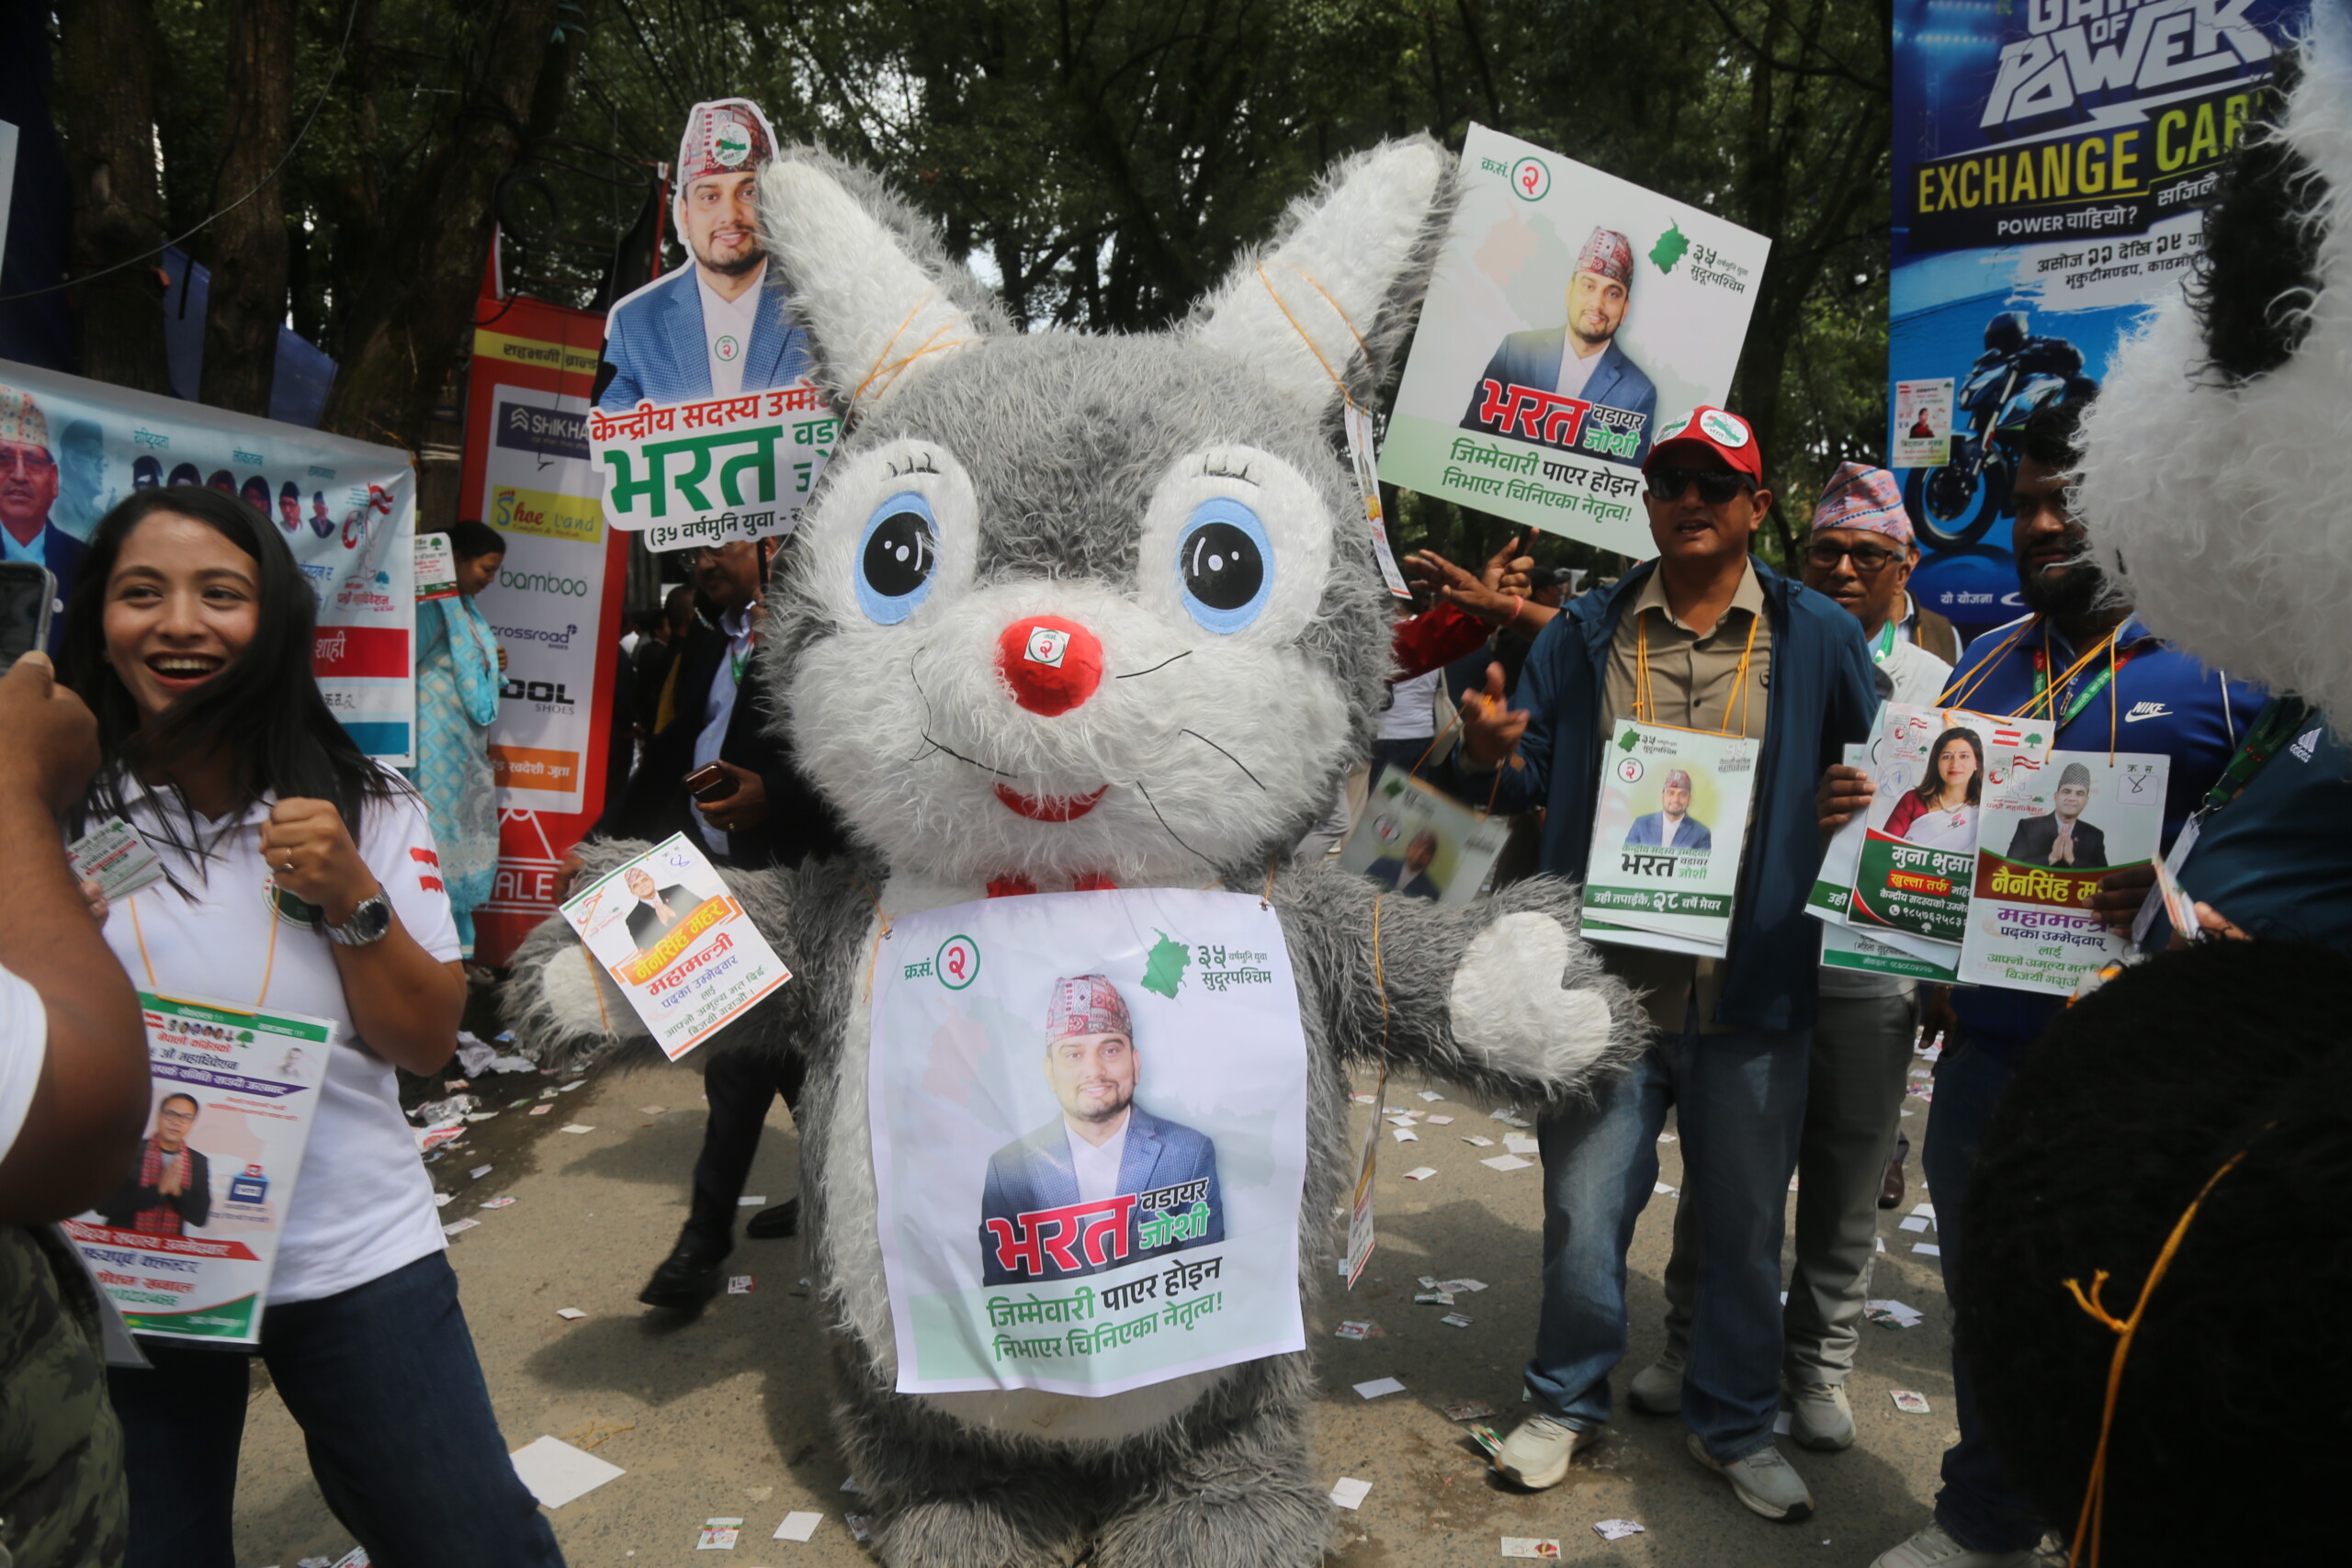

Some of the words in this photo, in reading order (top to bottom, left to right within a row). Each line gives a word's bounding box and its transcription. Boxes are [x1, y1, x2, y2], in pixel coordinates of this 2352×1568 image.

[2090, 13, 2130, 45] OF
[1481, 156, 1509, 178] क्र.सं.
[1522, 166, 1540, 195] २
[1918, 130, 2140, 213] EXCHANGE
[1997, 214, 2064, 236] POWER
[1692, 243, 1717, 269] ३५
[2037, 252, 2085, 273] असोज
[2087, 245, 2112, 266] २२
[2119, 241, 2153, 260] देखि
[1690, 264, 1746, 295] सुदूरपश्चिम
[591, 402, 675, 442] केन्द्रीय
[682, 395, 760, 429] सदस्य
[1479, 378, 1593, 447] भरत
[1593, 402, 1646, 430] वडायर
[1583, 424, 1641, 459] जोशी
[604, 424, 783, 518] भरत
[1450, 436, 1540, 477] जिम्मेवारी
[1542, 460, 1589, 486] पाएर
[1589, 467, 1640, 498] होइन
[1442, 466, 1504, 496] निभाएर
[1505, 479, 1581, 512] चिनिएका
[1581, 493, 1633, 524] नेतृत्व!
[683, 513, 738, 541] वर्षमुनि
[743, 511, 775, 536] युवा
[500, 566, 587, 597] bamboo
[1940, 592, 1953, 604] यो
[1957, 591, 1994, 604] योजना
[315, 630, 346, 662] शाही
[1040, 639, 1053, 659] २
[535, 704, 574, 715] SHOES
[2132, 701, 2166, 715] NIKE
[1642, 735, 1657, 746] ३५
[2289, 743, 2312, 763] adidas
[1625, 765, 1635, 780] २
[1622, 853, 1678, 877] भरत
[1892, 845, 1930, 869] मुना
[1678, 866, 1707, 880] जोशी
[1891, 873, 1924, 888] खुल्ला
[1927, 878, 1949, 893] तर्फ
[1991, 865, 2073, 902] नैनसिंह
[1594, 890, 1611, 904] उही
[1653, 891, 1679, 913] २८
[1700, 897, 1722, 911] मेयर
[1827, 892, 1848, 908] उही
[1880, 887, 1908, 902] केन्द्रीय
[1908, 895, 1946, 909] सदस्यको
[633, 932, 689, 980] नैनसिंह
[685, 898, 725, 935] महर
[2001, 926, 2041, 941] पदका
[2041, 931, 2108, 952] उम्मेदवार
[2039, 945, 2064, 959] लाई
[645, 932, 734, 997] महामन्त्री
[904, 957, 933, 980] क्र.सं.
[948, 946, 966, 980] २
[1197, 944, 1227, 969] ३५
[1228, 950, 1253, 964] वर्षमुनि
[1254, 953, 1268, 964] युवा
[1987, 953, 2024, 966] आफ्नो
[2026, 957, 2066, 973] अमूल्य
[661, 985, 691, 1010] पदका
[692, 954, 739, 990] उम्मेदवार
[701, 984, 717, 1000] लाई
[1201, 966, 1272, 992] सुदूरपश्चिम
[663, 1014, 695, 1039] आफ्नो
[697, 991, 728, 1018] अमूल्य
[729, 982, 745, 996] मत
[1141, 1178, 1209, 1212] वडायर
[986, 1193, 1137, 1276] भरत
[1138, 1201, 1210, 1250] जोशी
[986, 1286, 1095, 1327] जिम्मेवारी
[1102, 1274, 1159, 1312] पाएर
[1162, 1256, 1224, 1298] होइन
[992, 1334, 1062, 1362] निभाएर
[1066, 1312, 1159, 1357] चिनिएका
[1162, 1292, 1223, 1331] नेतृत्व!
